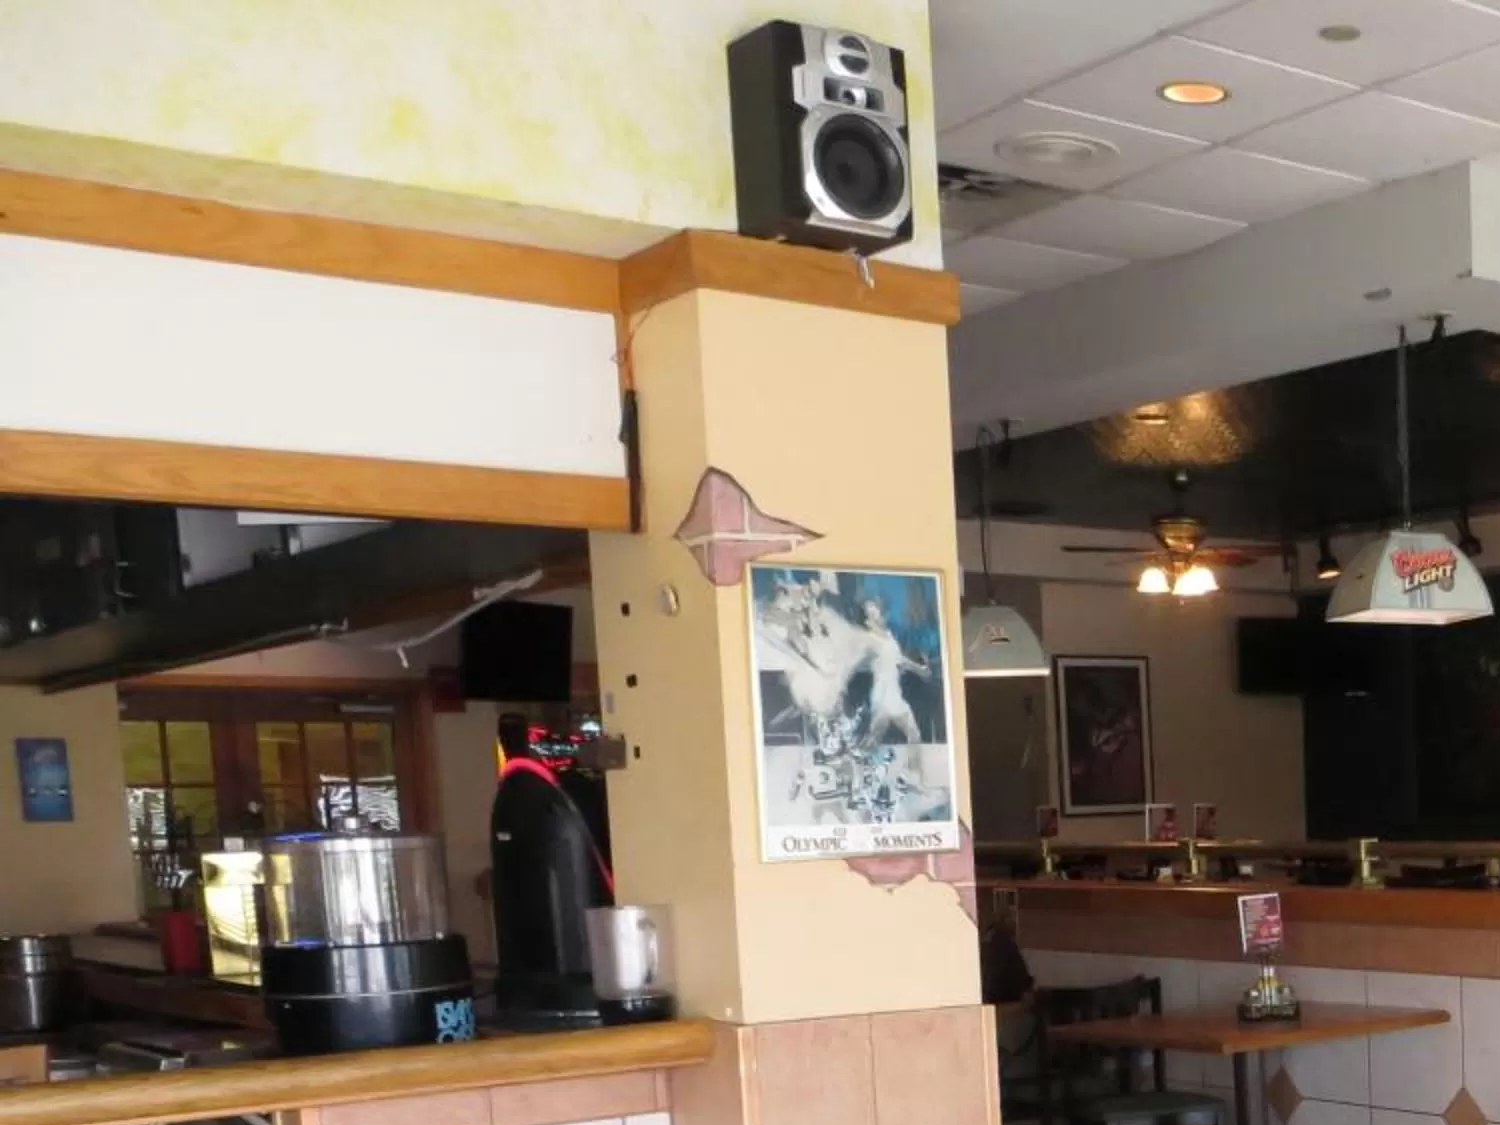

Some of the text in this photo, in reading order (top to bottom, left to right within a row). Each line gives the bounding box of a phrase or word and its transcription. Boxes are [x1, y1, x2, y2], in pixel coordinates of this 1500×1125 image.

[1404, 564, 1453, 591] LIGHT
[782, 832, 943, 852] OLYMPIC MOMENTS
